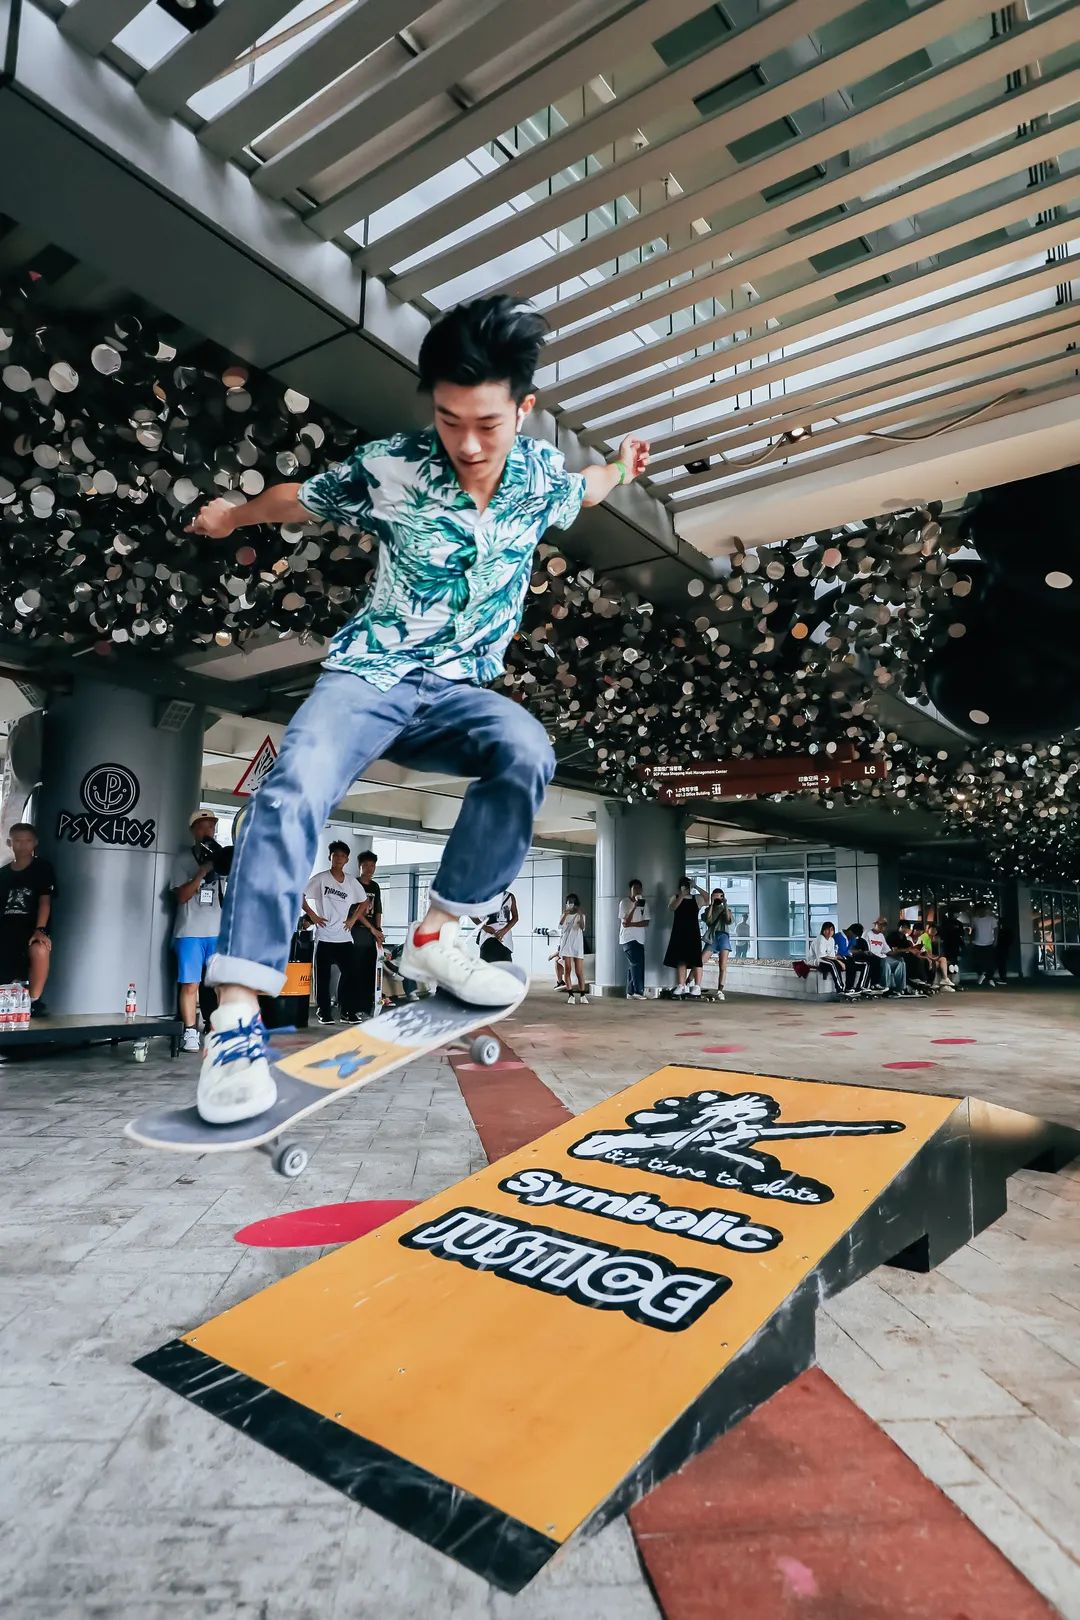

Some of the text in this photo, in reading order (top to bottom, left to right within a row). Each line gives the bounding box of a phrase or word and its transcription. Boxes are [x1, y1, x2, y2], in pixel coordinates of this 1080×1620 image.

[864, 765, 876, 775] L6
[58, 813, 153, 845] PSYCHOS
[324, 886, 348, 900] THRASHER
[605, 1149, 821, 1203] it's time to skate
[506, 1170, 774, 1249] Symbolic
[411, 1211, 717, 1324] JUSTICE
